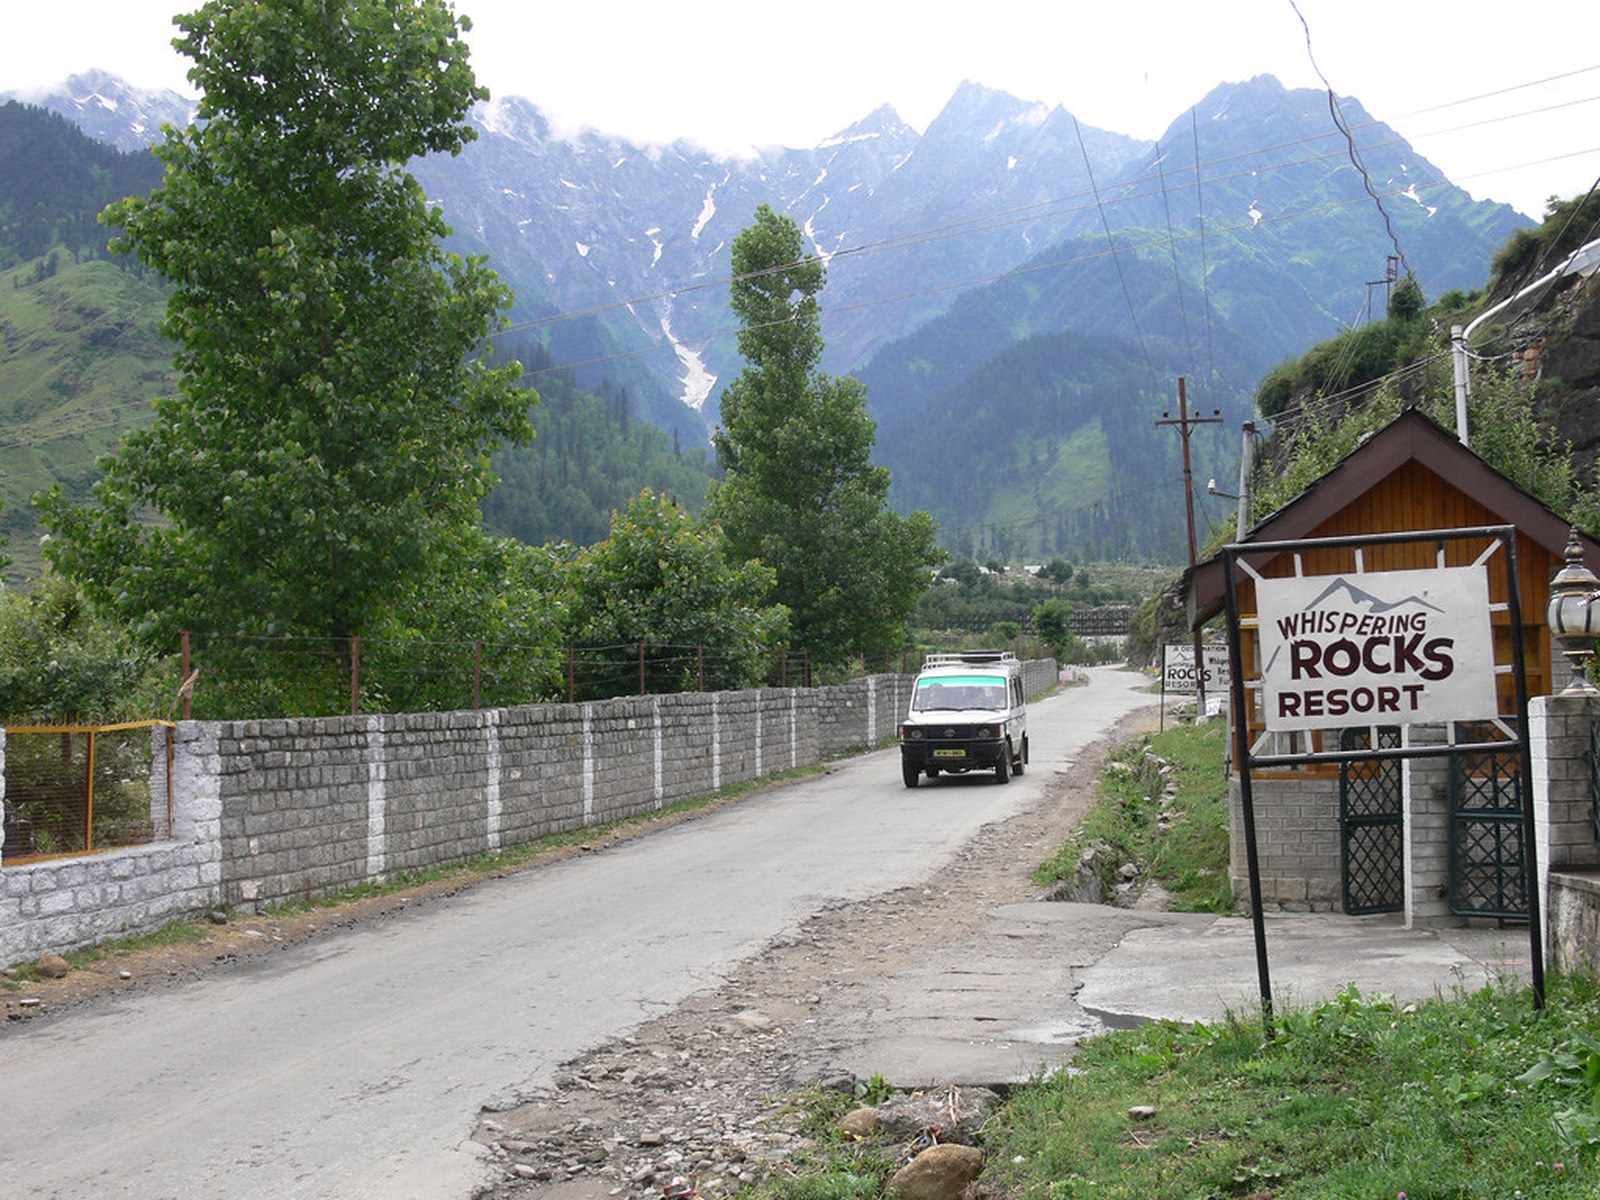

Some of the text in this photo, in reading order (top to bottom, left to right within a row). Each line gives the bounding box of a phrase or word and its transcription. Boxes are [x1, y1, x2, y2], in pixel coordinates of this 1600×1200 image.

[1277, 611, 1427, 640] WHISPERING
[1290, 633, 1454, 680] ROCKS
[1168, 668, 1211, 682] ROCS
[1278, 684, 1425, 717] RESORT
